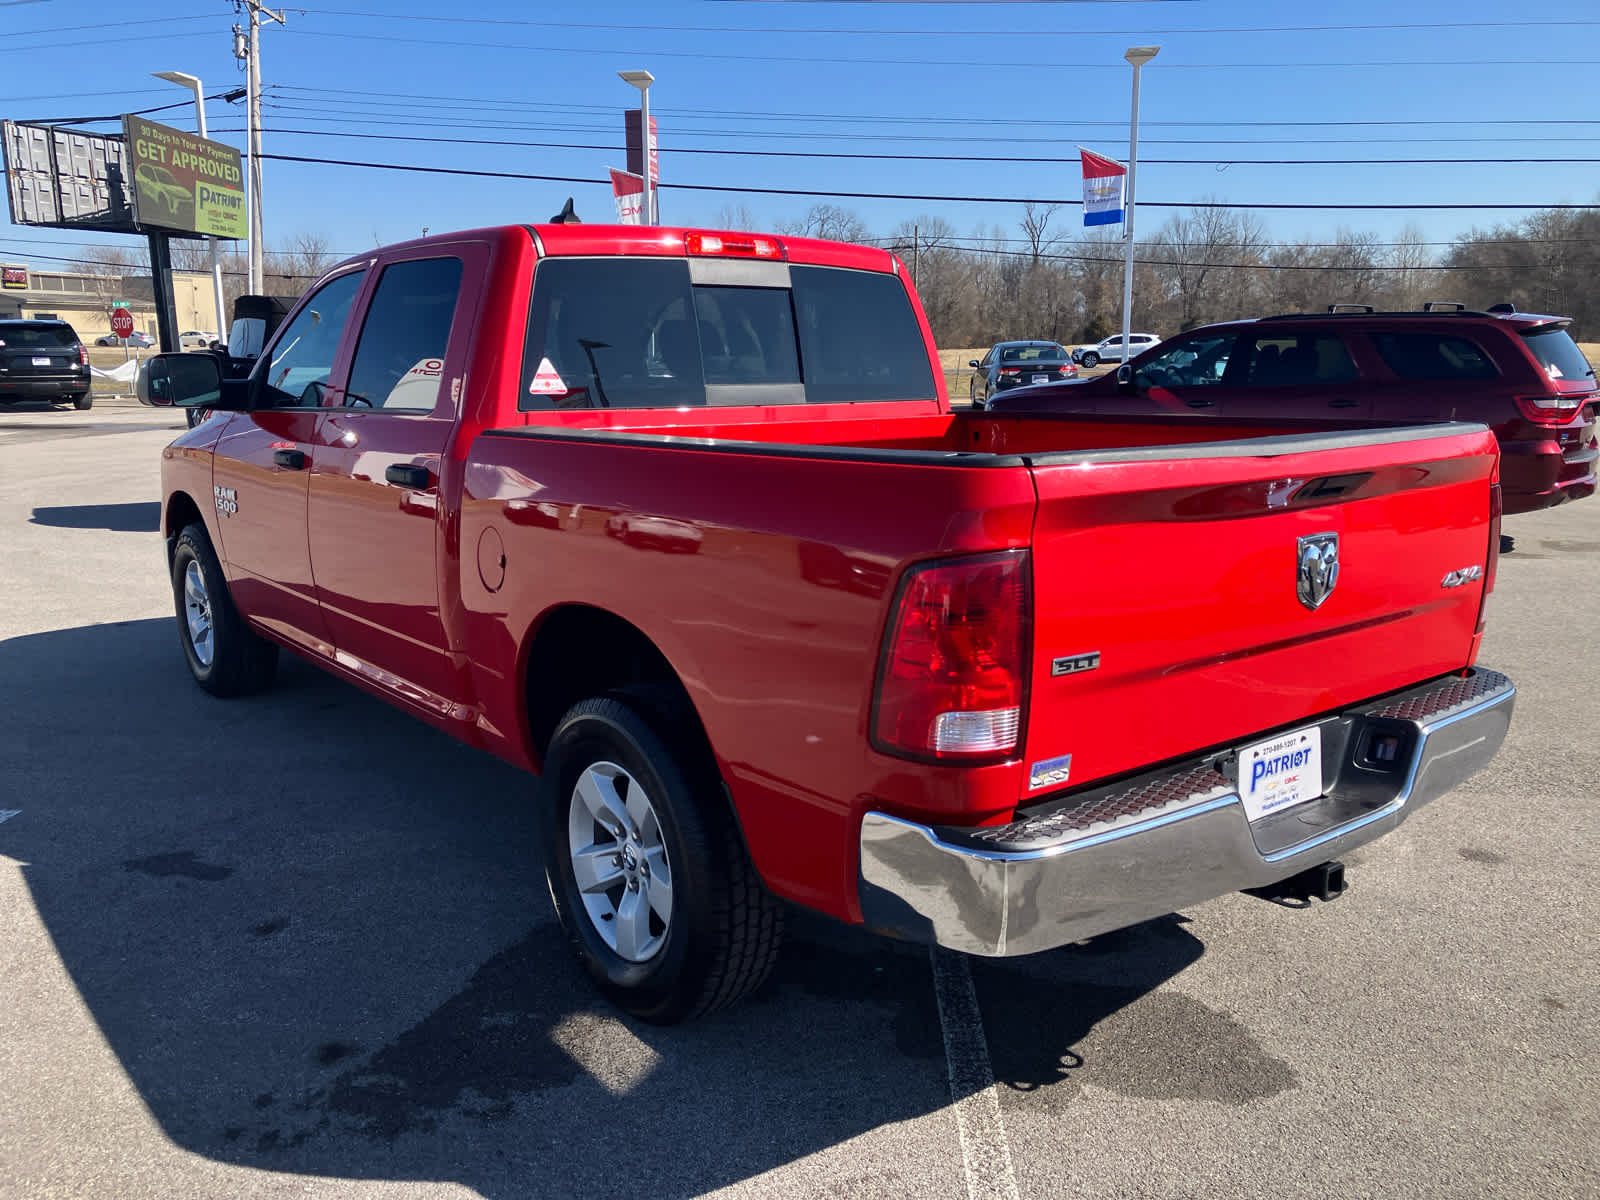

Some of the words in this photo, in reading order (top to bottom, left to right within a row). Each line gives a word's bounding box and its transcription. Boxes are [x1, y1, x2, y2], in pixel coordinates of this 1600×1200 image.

[136, 139, 166, 163] GET
[172, 149, 240, 183] APPROVED
[113, 317, 132, 329] STOP
[214, 485, 236, 501] RAM
[215, 497, 237, 513] 1500
[1055, 654, 1100, 673] SLT
[1251, 748, 1311, 793] PATRIOT
